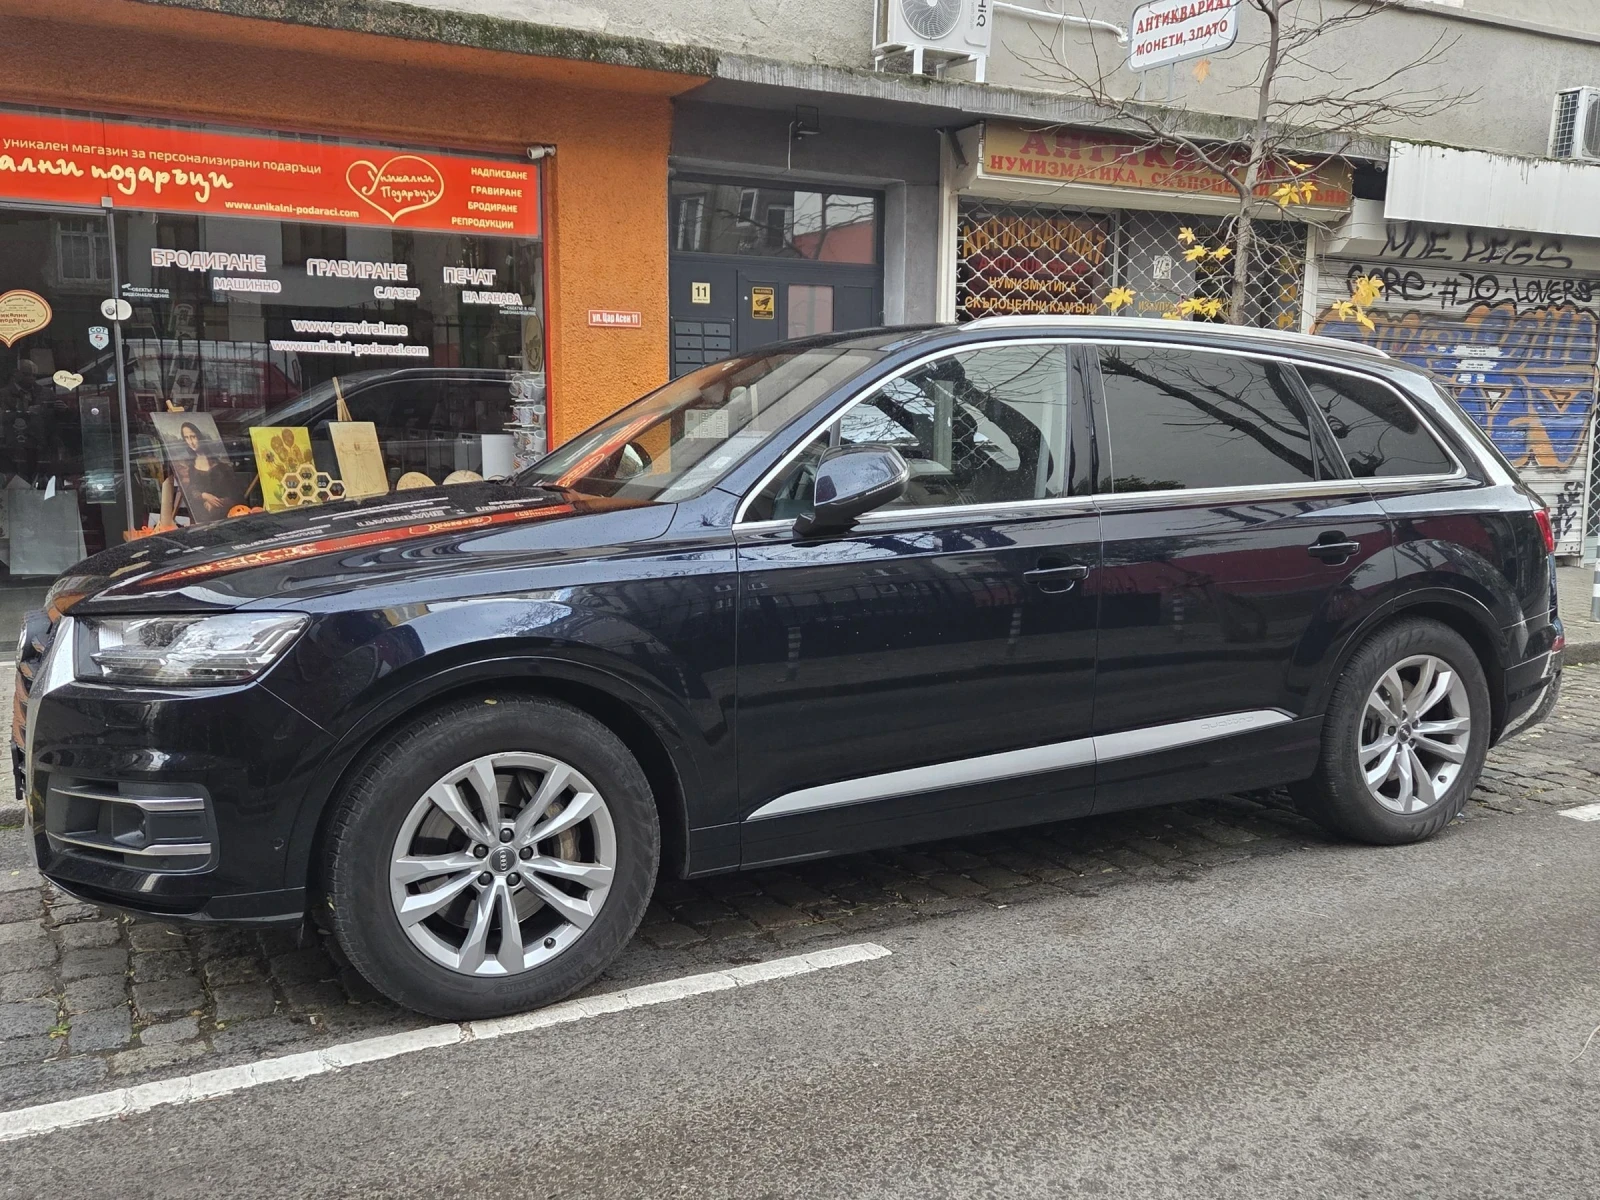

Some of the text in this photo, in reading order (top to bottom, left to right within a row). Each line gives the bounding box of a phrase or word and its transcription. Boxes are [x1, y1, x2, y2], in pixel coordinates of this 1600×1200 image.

[1136, 20, 1229, 57] МОНЕТИ, ЗЛАТО
[3, 137, 321, 175] уникален магазин за персонализирани подаръци
[471, 167, 528, 181] НАДПИСВАНЕ
[990, 155, 1142, 187] НУМИЗМАТИКА,
[91, 163, 234, 203] подаръци
[361, 170, 435, 196] Уникални
[471, 185, 523, 198] ГРАВИРАНЕ
[380, 186, 438, 203] Подаръци
[225, 200, 360, 219] www.unikalni-podaraci.com
[467, 201, 518, 213] БРОДИРАНЕ
[451, 217, 514, 230] РЕПРОДУКЦИИ
[151, 247, 267, 272] БРОДИРАНЕ
[306, 258, 408, 281] ГРАВИРАНЕ
[443, 266, 496, 286] ПЕЧАТ
[213, 277, 281, 293] МАШИННО
[695, 286, 707, 298] 11
[988, 276, 1077, 293] НУМИЗМАТИКА
[462, 290, 524, 305] НА КАНАВА
[964, 295, 1099, 315] СКЪПОЦЕННИ КАМЪНИ
[592, 312, 638, 324] ул. Цар Асен 11
[270, 340, 429, 357] www.unikalni-podaraci.com
